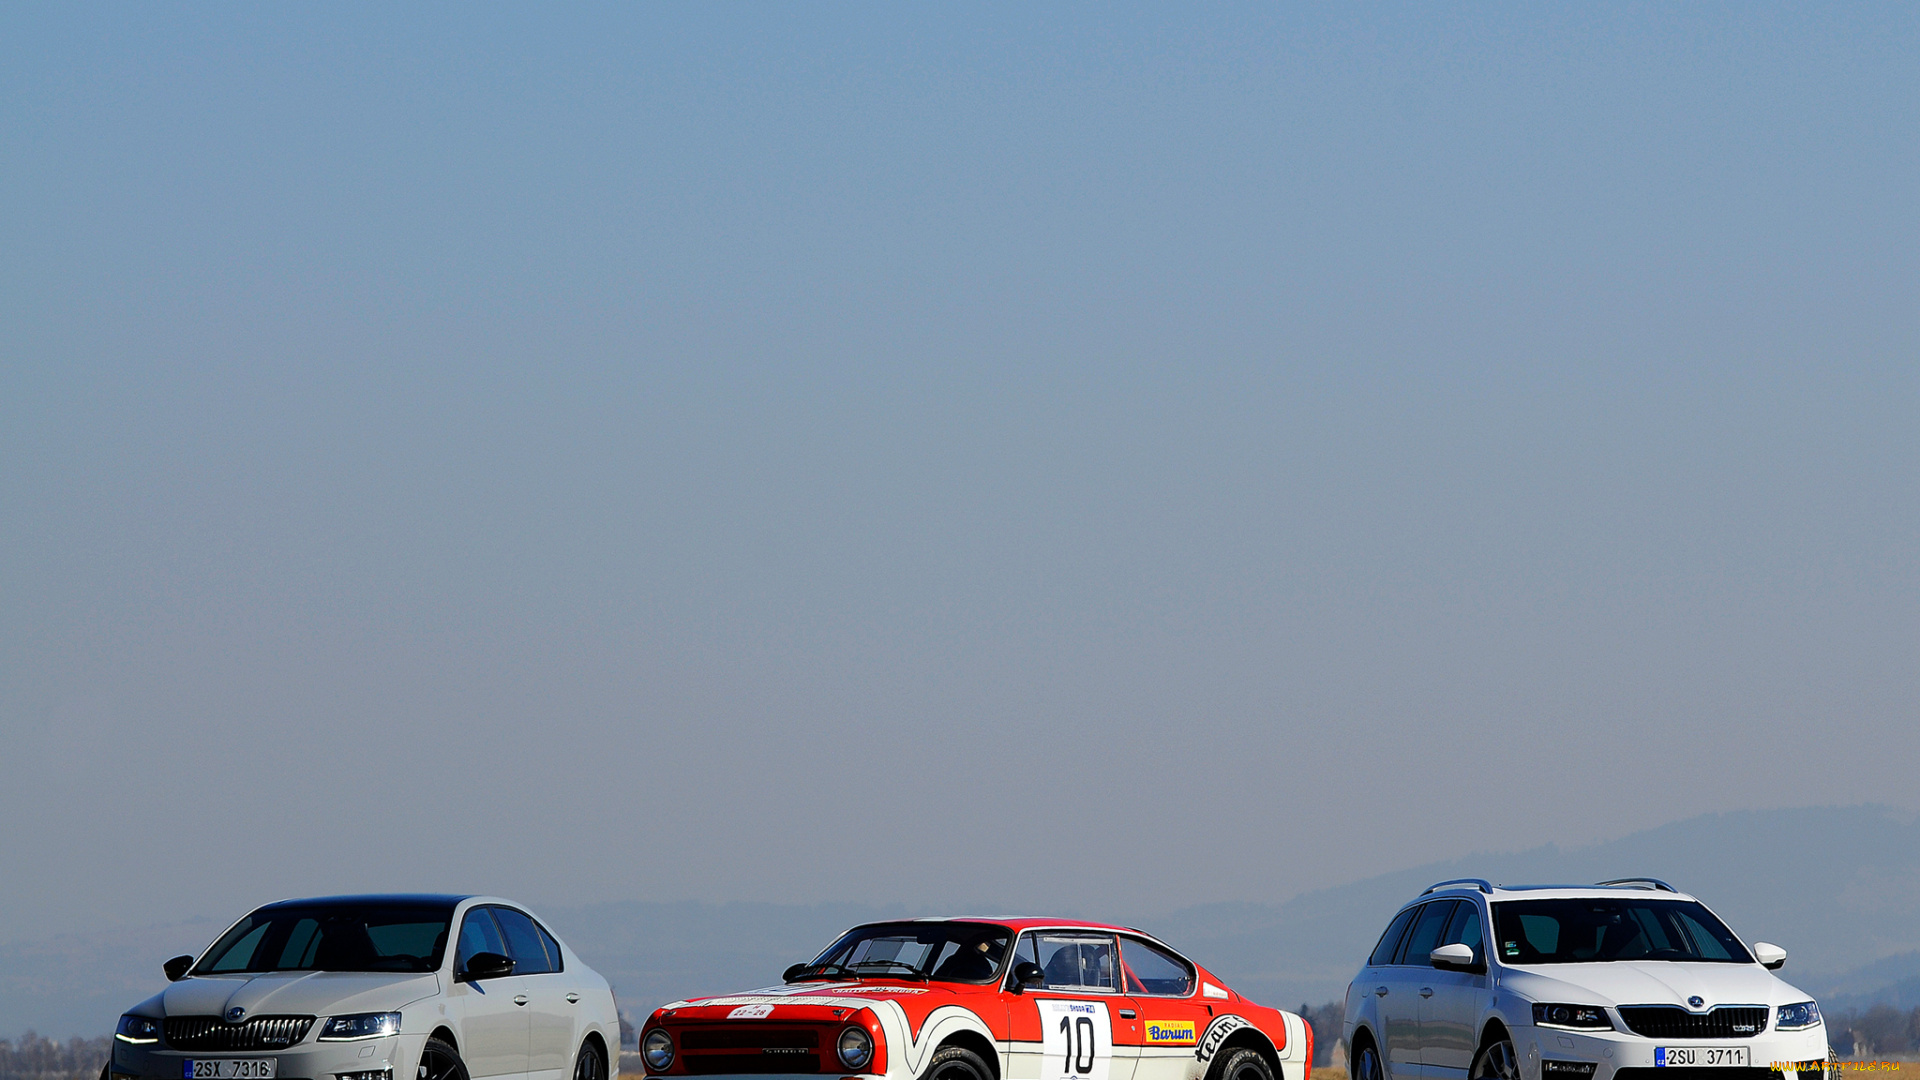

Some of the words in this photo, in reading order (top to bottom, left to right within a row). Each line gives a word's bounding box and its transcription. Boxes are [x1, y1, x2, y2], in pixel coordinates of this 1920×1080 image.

[1149, 1026, 1194, 1040] Barum
[1060, 1016, 1095, 1074] 10
[1195, 1021, 1238, 1063] team
[1668, 1050, 1695, 1065] 2SU
[1707, 1050, 1741, 1065] 3711
[195, 1061, 220, 1077] 2SX
[232, 1061, 269, 1077] 7316
